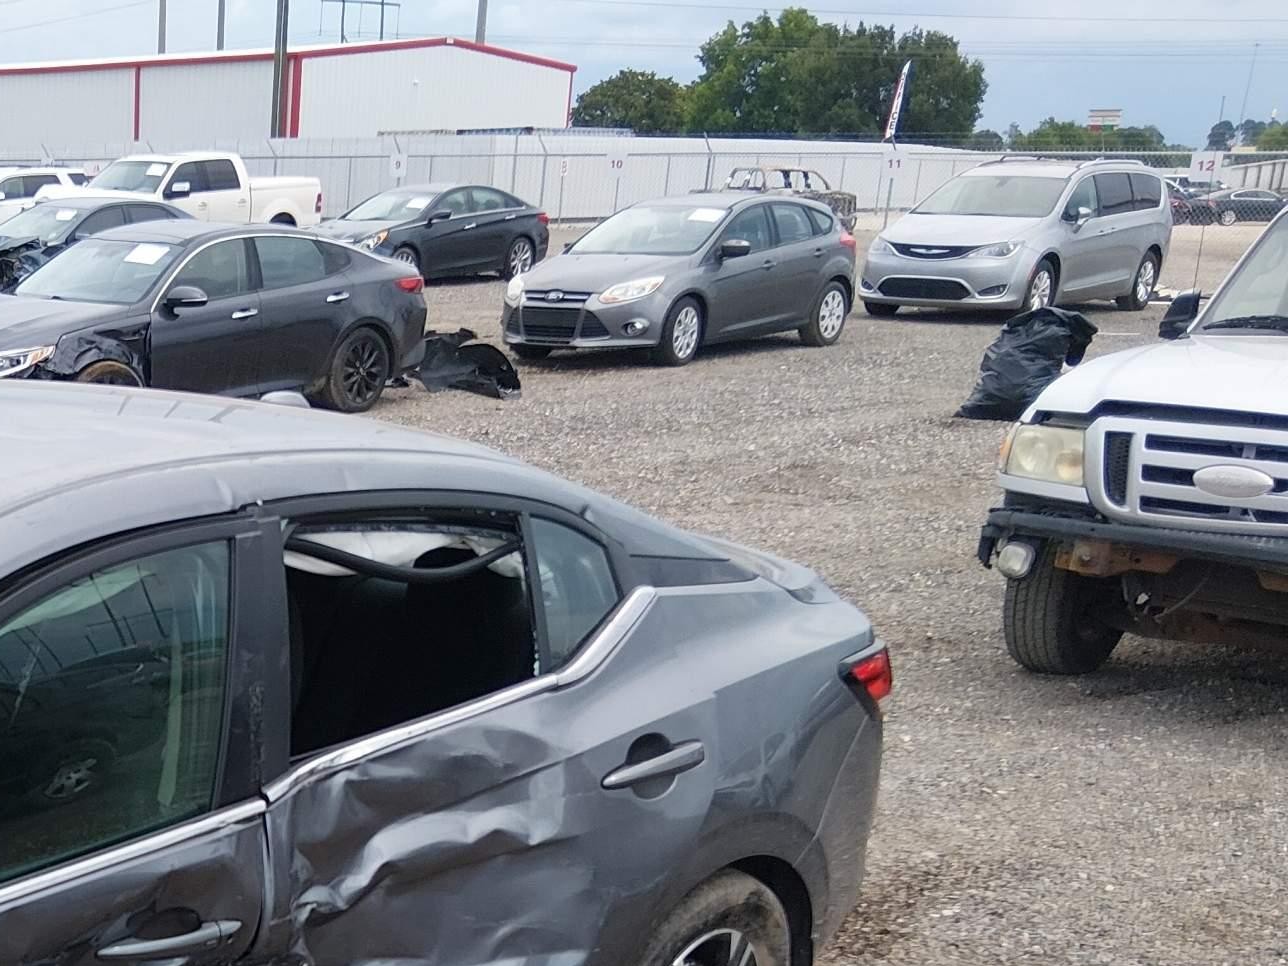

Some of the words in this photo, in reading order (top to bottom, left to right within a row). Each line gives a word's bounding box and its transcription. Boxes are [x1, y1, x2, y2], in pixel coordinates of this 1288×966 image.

[610, 159, 624, 169] 10
[887, 158, 902, 169] 11
[1197, 159, 1216, 172] 12
